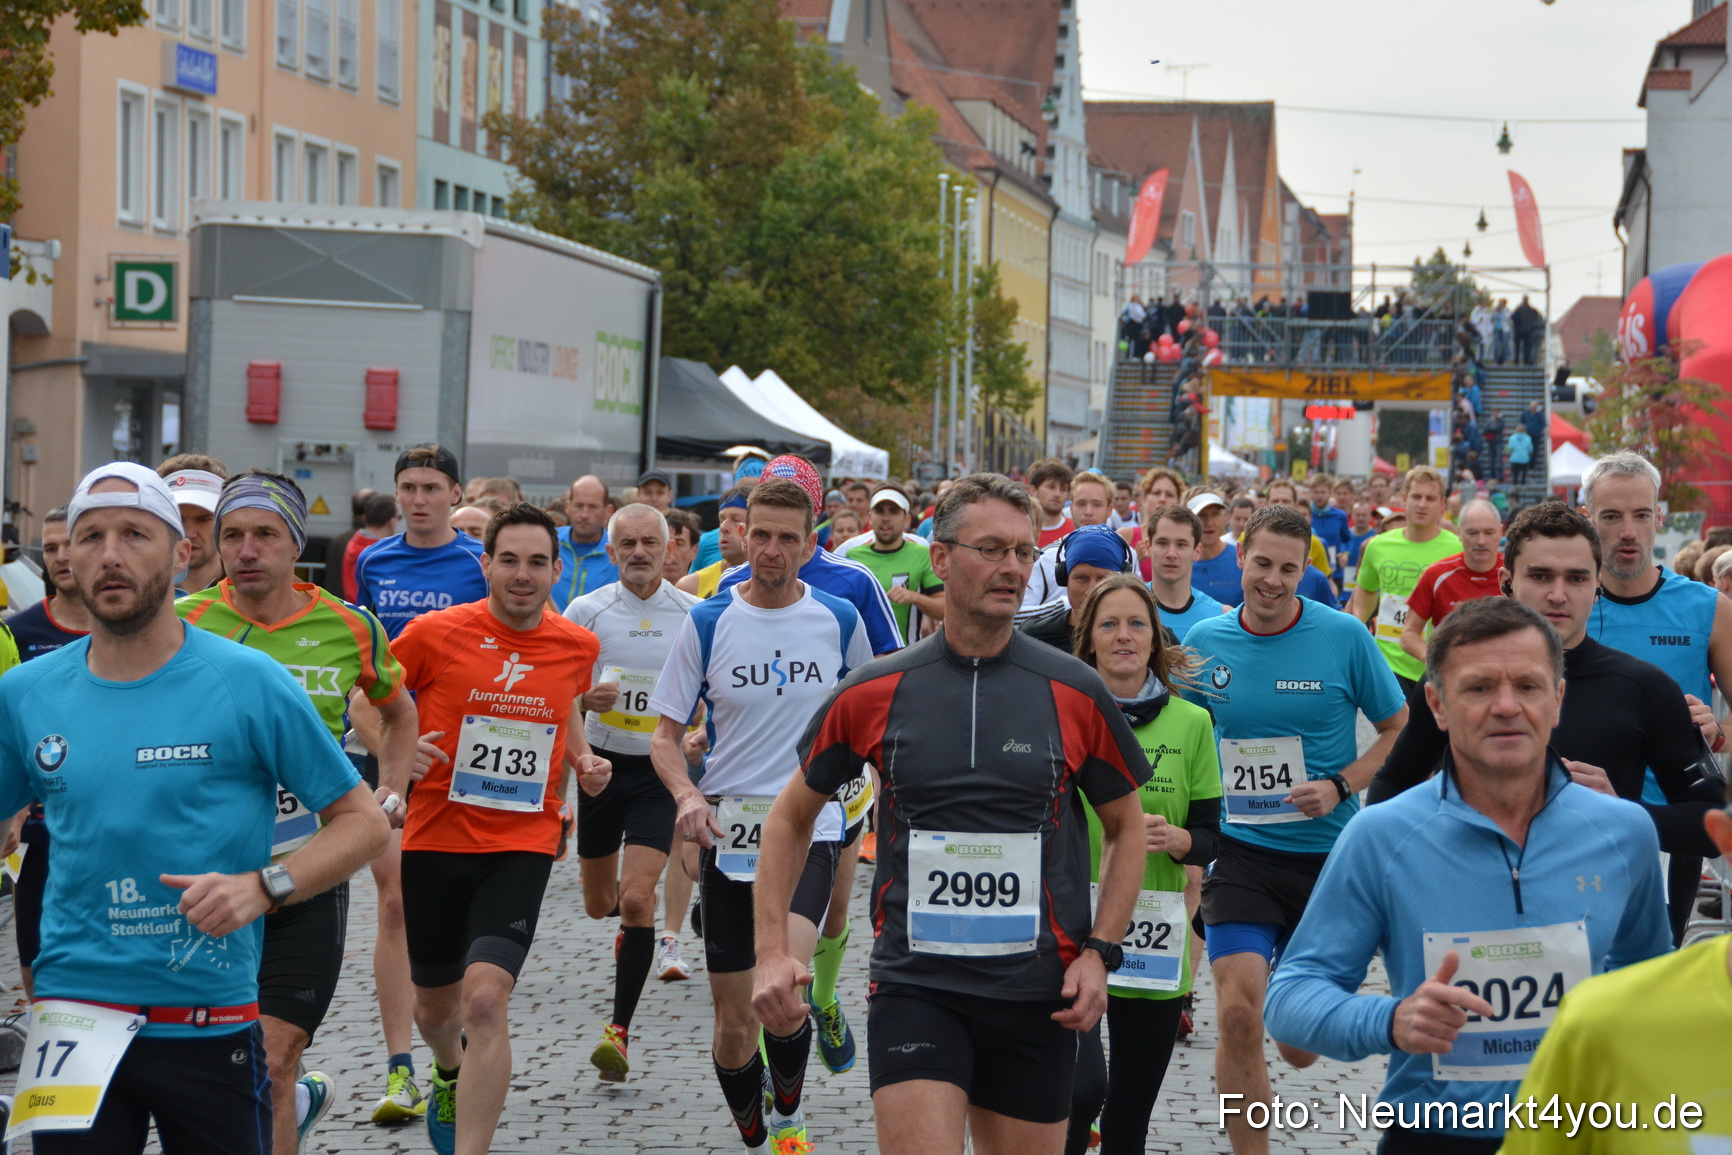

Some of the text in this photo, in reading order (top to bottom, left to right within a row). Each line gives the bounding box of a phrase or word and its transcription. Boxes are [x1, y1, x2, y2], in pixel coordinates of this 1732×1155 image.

[124, 269, 168, 314] D
[594, 333, 643, 413] BOCK
[1304, 375, 1358, 397] ZIEL
[378, 590, 453, 609] SYSCAD
[1649, 635, 1691, 647] THULE
[1276, 680, 1322, 690] BOCK
[467, 688, 546, 706] funrunners
[622, 689, 649, 712] 16
[490, 703, 555, 719] neumarkt
[498, 727, 532, 739] BOCK
[136, 744, 212, 763] BOCK
[1009, 741, 1031, 753] asics
[1245, 745, 1276, 754] BOCK
[469, 743, 537, 776] 2133
[1233, 763, 1293, 791] 2154
[481, 780, 518, 795] Michael
[1161, 786, 1175, 794] BEST
[1248, 799, 1281, 810] Markus
[730, 823, 761, 849] 24
[958, 845, 1003, 855] BOCK
[105, 877, 147, 905] 18.
[927, 869, 1020, 908] 2999
[1136, 899, 1162, 909] OCK
[111, 918, 182, 936] Stadtlauf
[1488, 941, 1543, 957] BOCK
[1120, 957, 1146, 970] isela
[49, 1012, 97, 1029] BOCK
[219, 1014, 244, 1022] balance
[1482, 1037, 1541, 1055] Michae
[35, 1040, 79, 1079] 17
[28, 1093, 56, 1109] Claus
